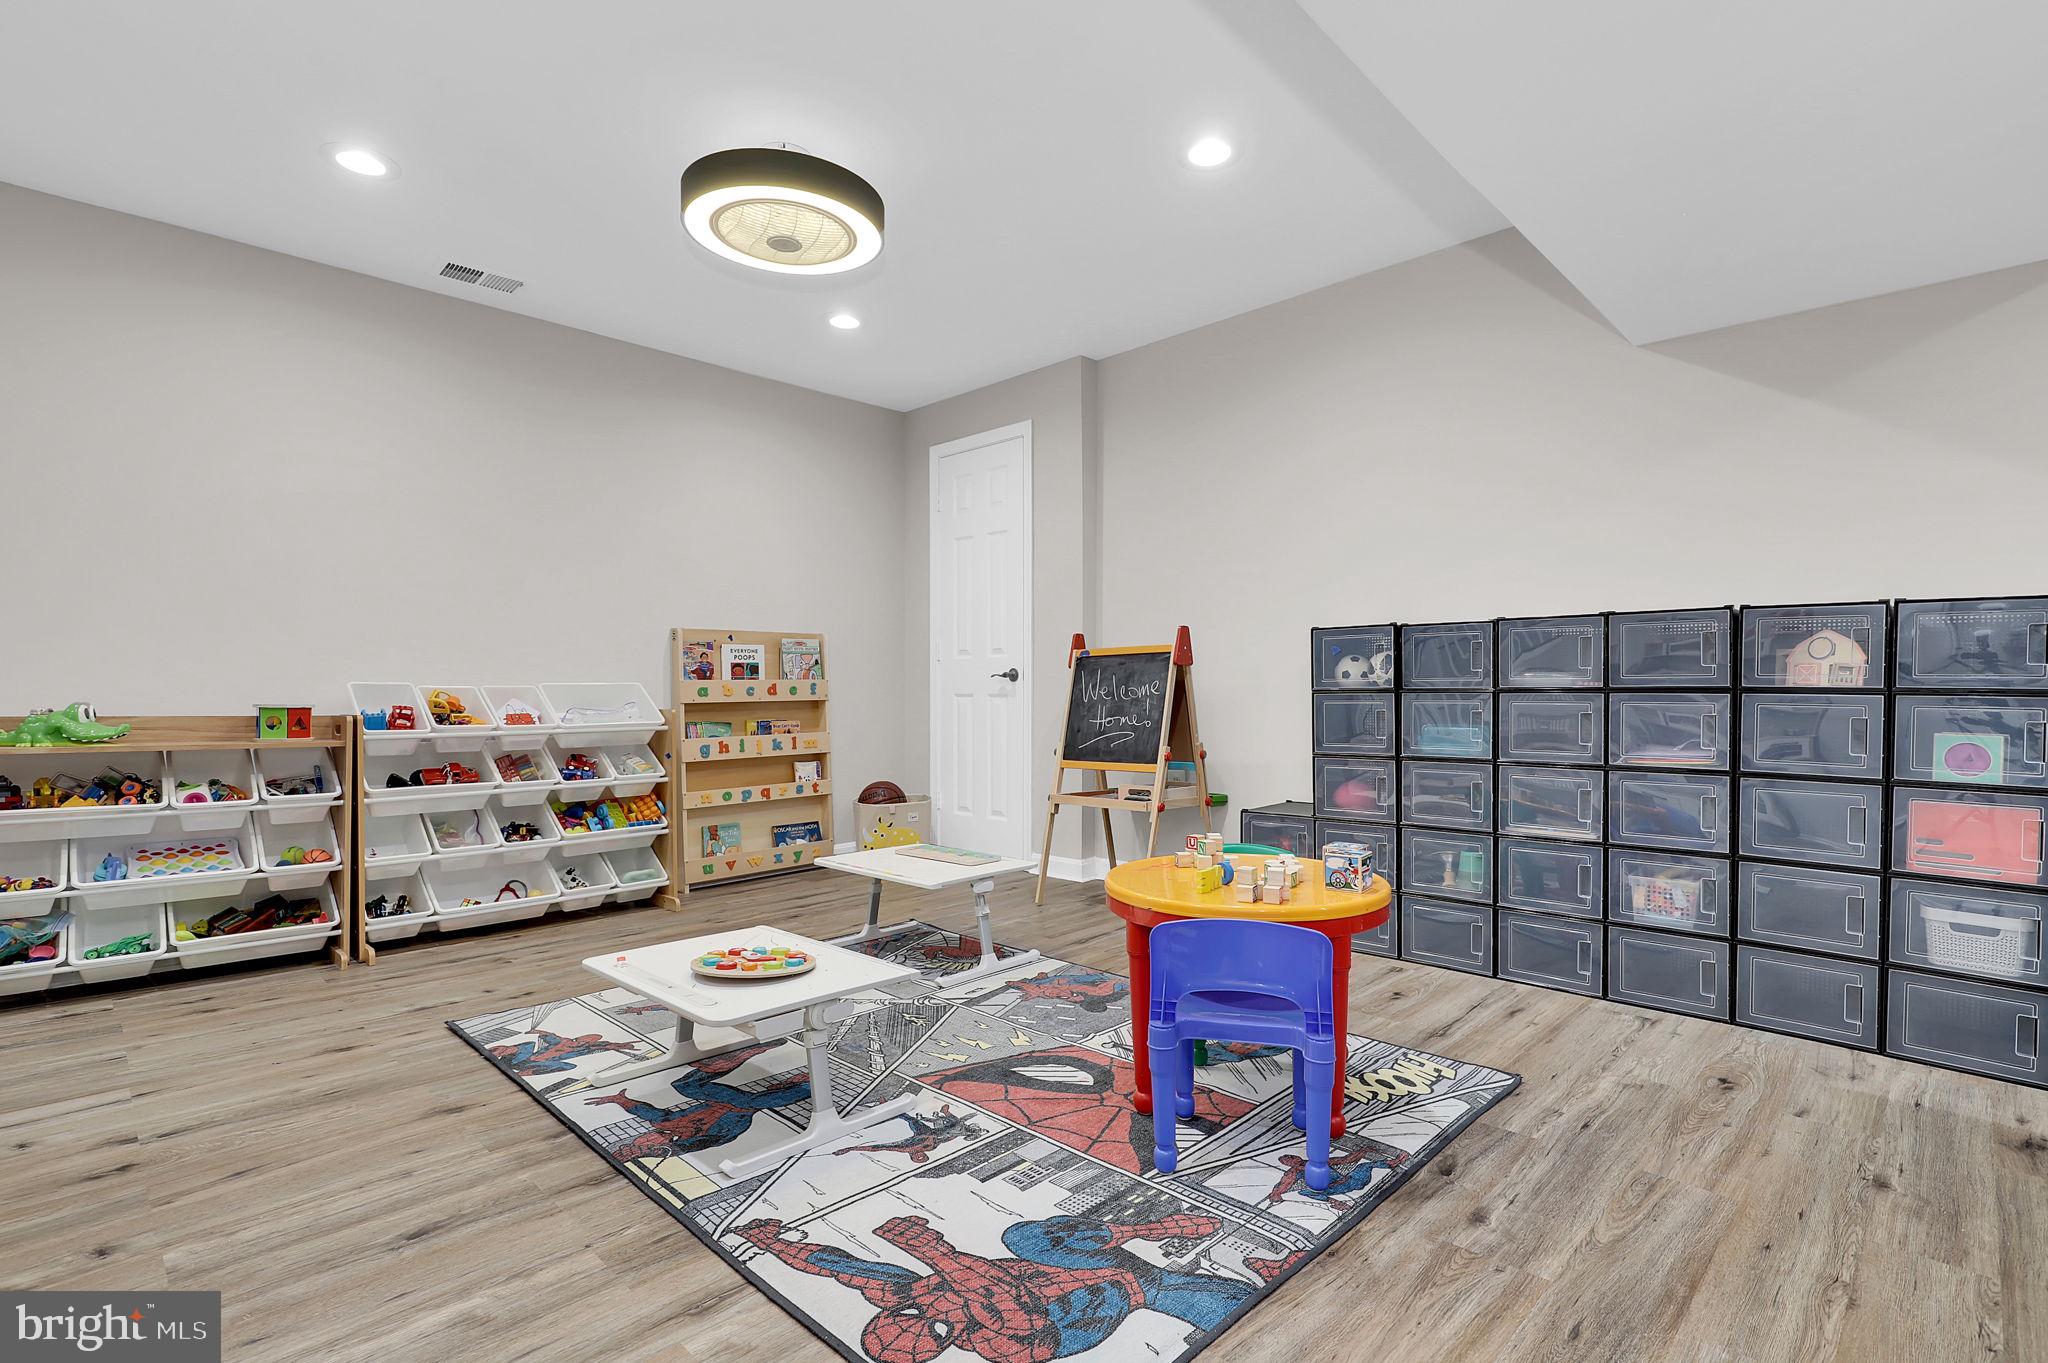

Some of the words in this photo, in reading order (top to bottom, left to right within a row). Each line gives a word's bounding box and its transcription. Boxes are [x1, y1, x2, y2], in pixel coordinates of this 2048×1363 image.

[697, 686, 709, 697] a
[745, 686, 755, 697] c
[767, 683, 778, 696] d
[1081, 668, 1160, 702] Welcome
[1089, 697, 1152, 732] Home!
[700, 744, 711, 759] g
[718, 740, 730, 754] h
[771, 738, 783, 752] k
[722, 791, 733, 802] o
[741, 789, 752, 802] p
[760, 787, 771, 800] q
[796, 784, 804, 795] s
[812, 782, 820, 794] t
[702, 864, 714, 875] u
[726, 860, 737, 871] v
[793, 850, 803, 864] y
